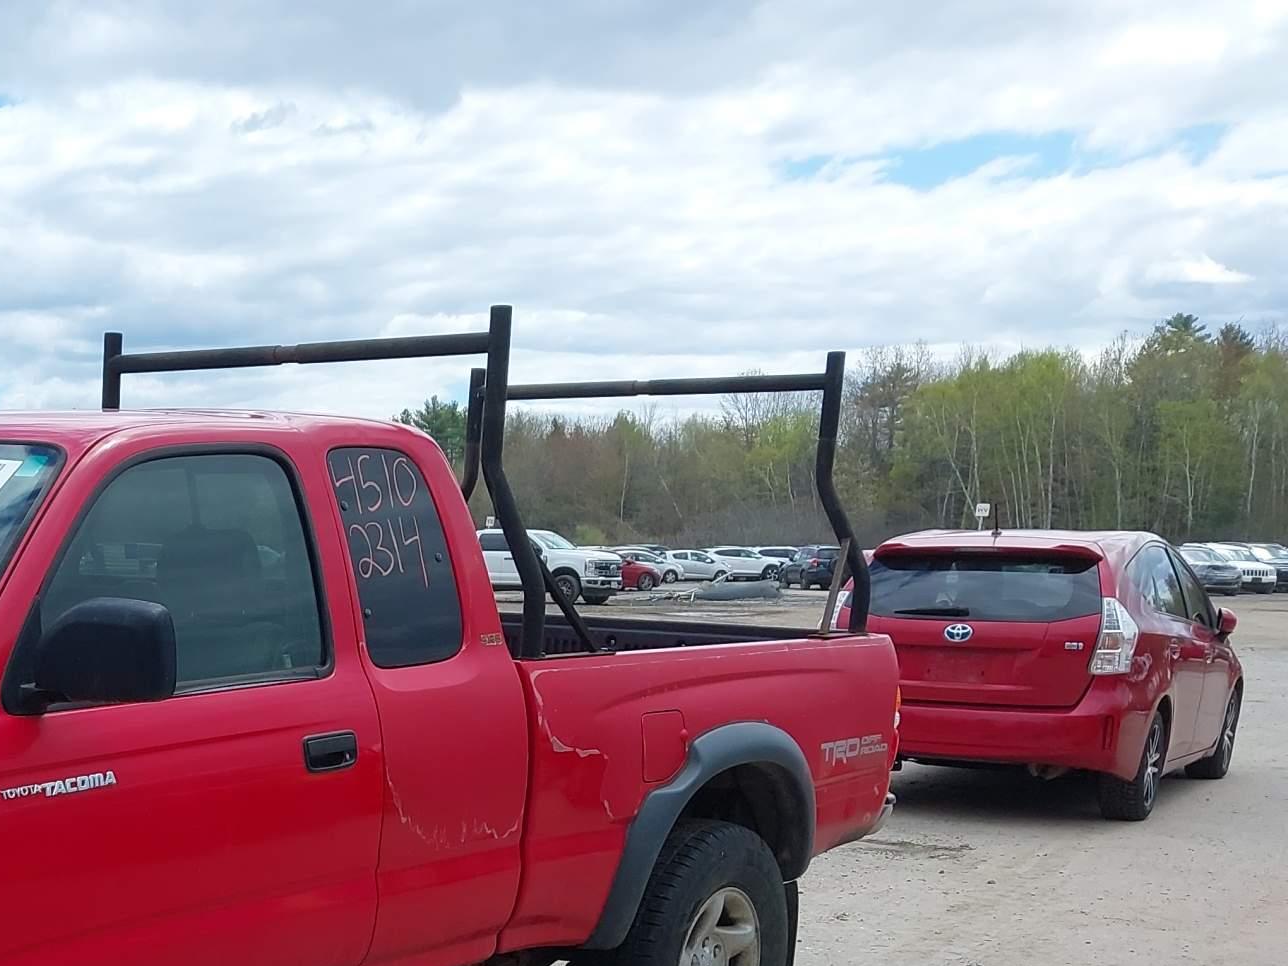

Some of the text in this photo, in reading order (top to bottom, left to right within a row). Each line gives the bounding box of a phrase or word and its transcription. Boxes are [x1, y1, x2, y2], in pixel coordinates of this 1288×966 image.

[328, 453, 417, 515] 4510
[348, 515, 429, 589] 2314
[821, 737, 860, 767] TRD
[860, 743, 888, 756] ROAD
[861, 734, 882, 745] OFF
[0, 770, 117, 800] TOYOTA TACOMA
